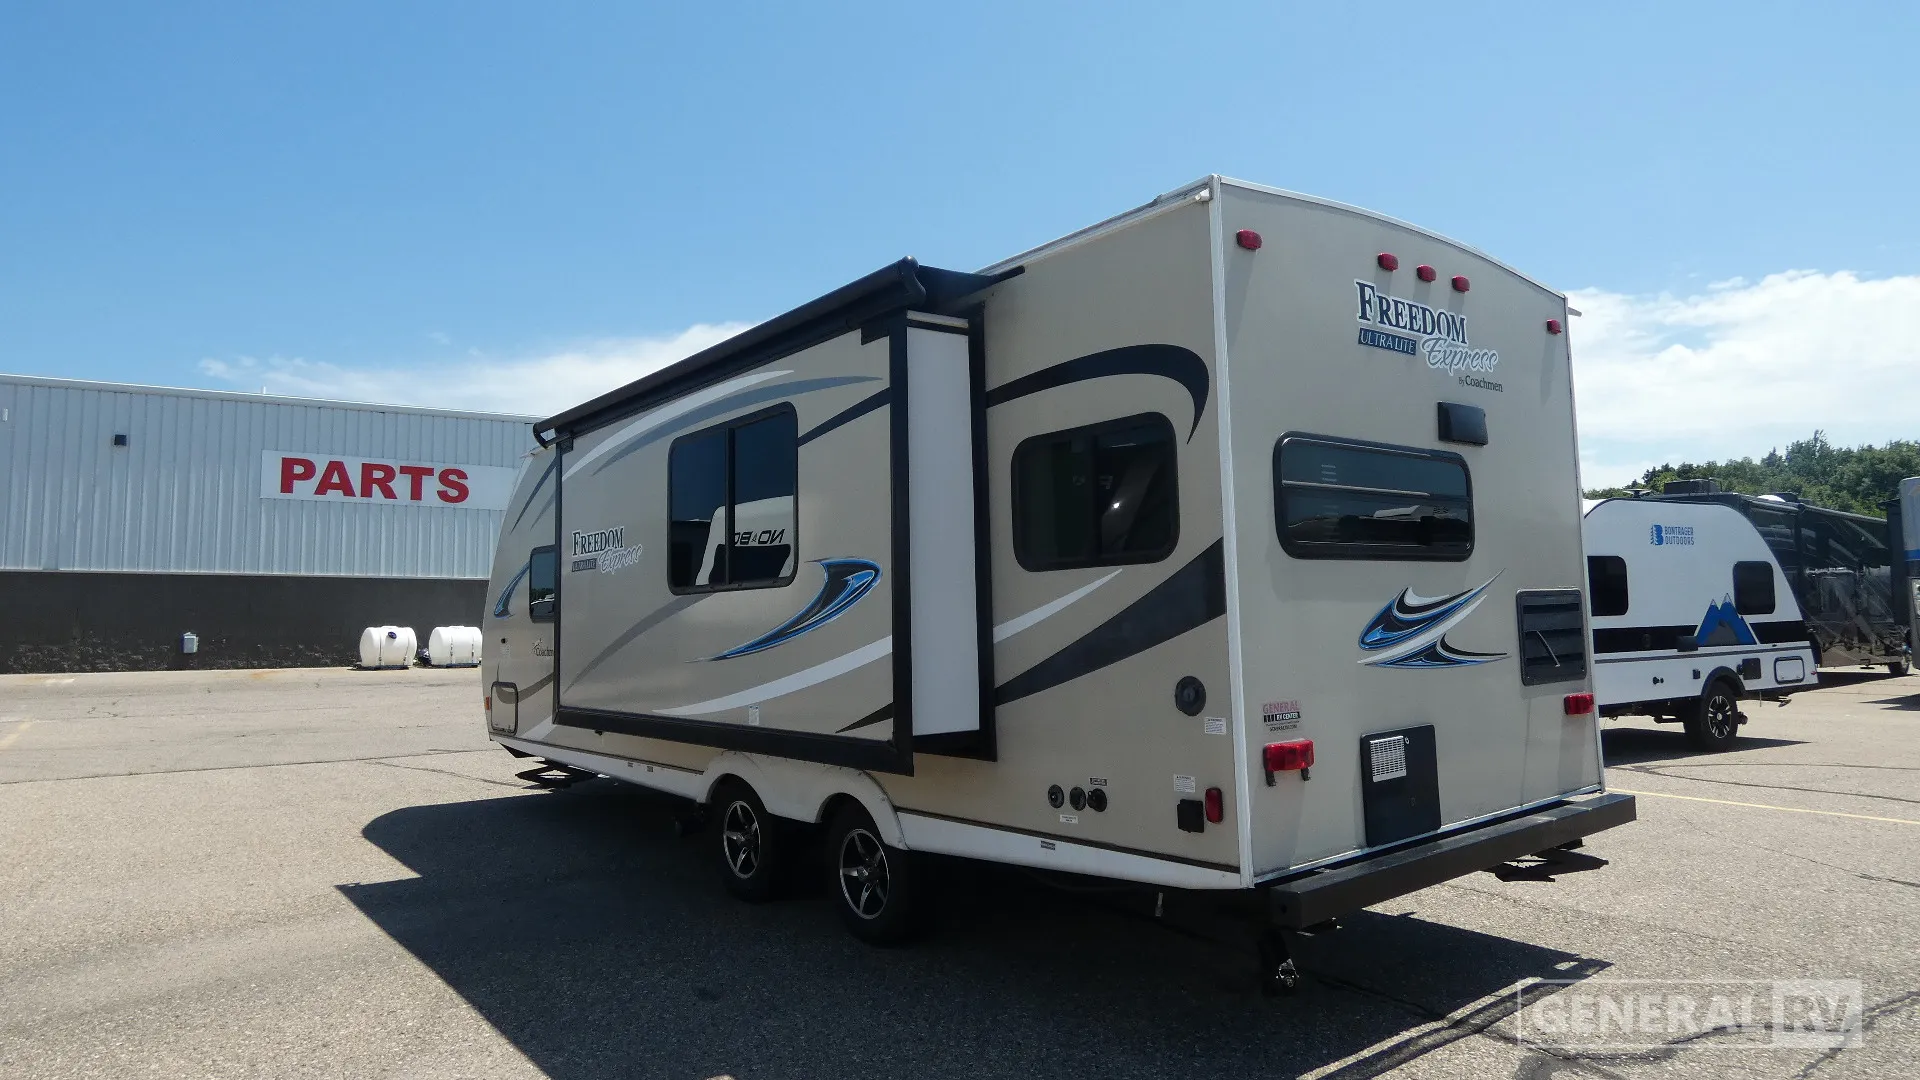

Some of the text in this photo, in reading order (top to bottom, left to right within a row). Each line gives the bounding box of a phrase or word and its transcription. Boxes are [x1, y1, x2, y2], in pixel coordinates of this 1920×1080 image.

[1421, 337, 1498, 375] Express
[1465, 375, 1504, 393] Coachmen
[280, 457, 470, 504] PARTS
[1664, 526, 1694, 536] BONTRAGER
[1664, 536, 1694, 545] OUTDOORS
[1263, 701, 1300, 714] GENERAL
[1283, 712, 1298, 720] CENTER
